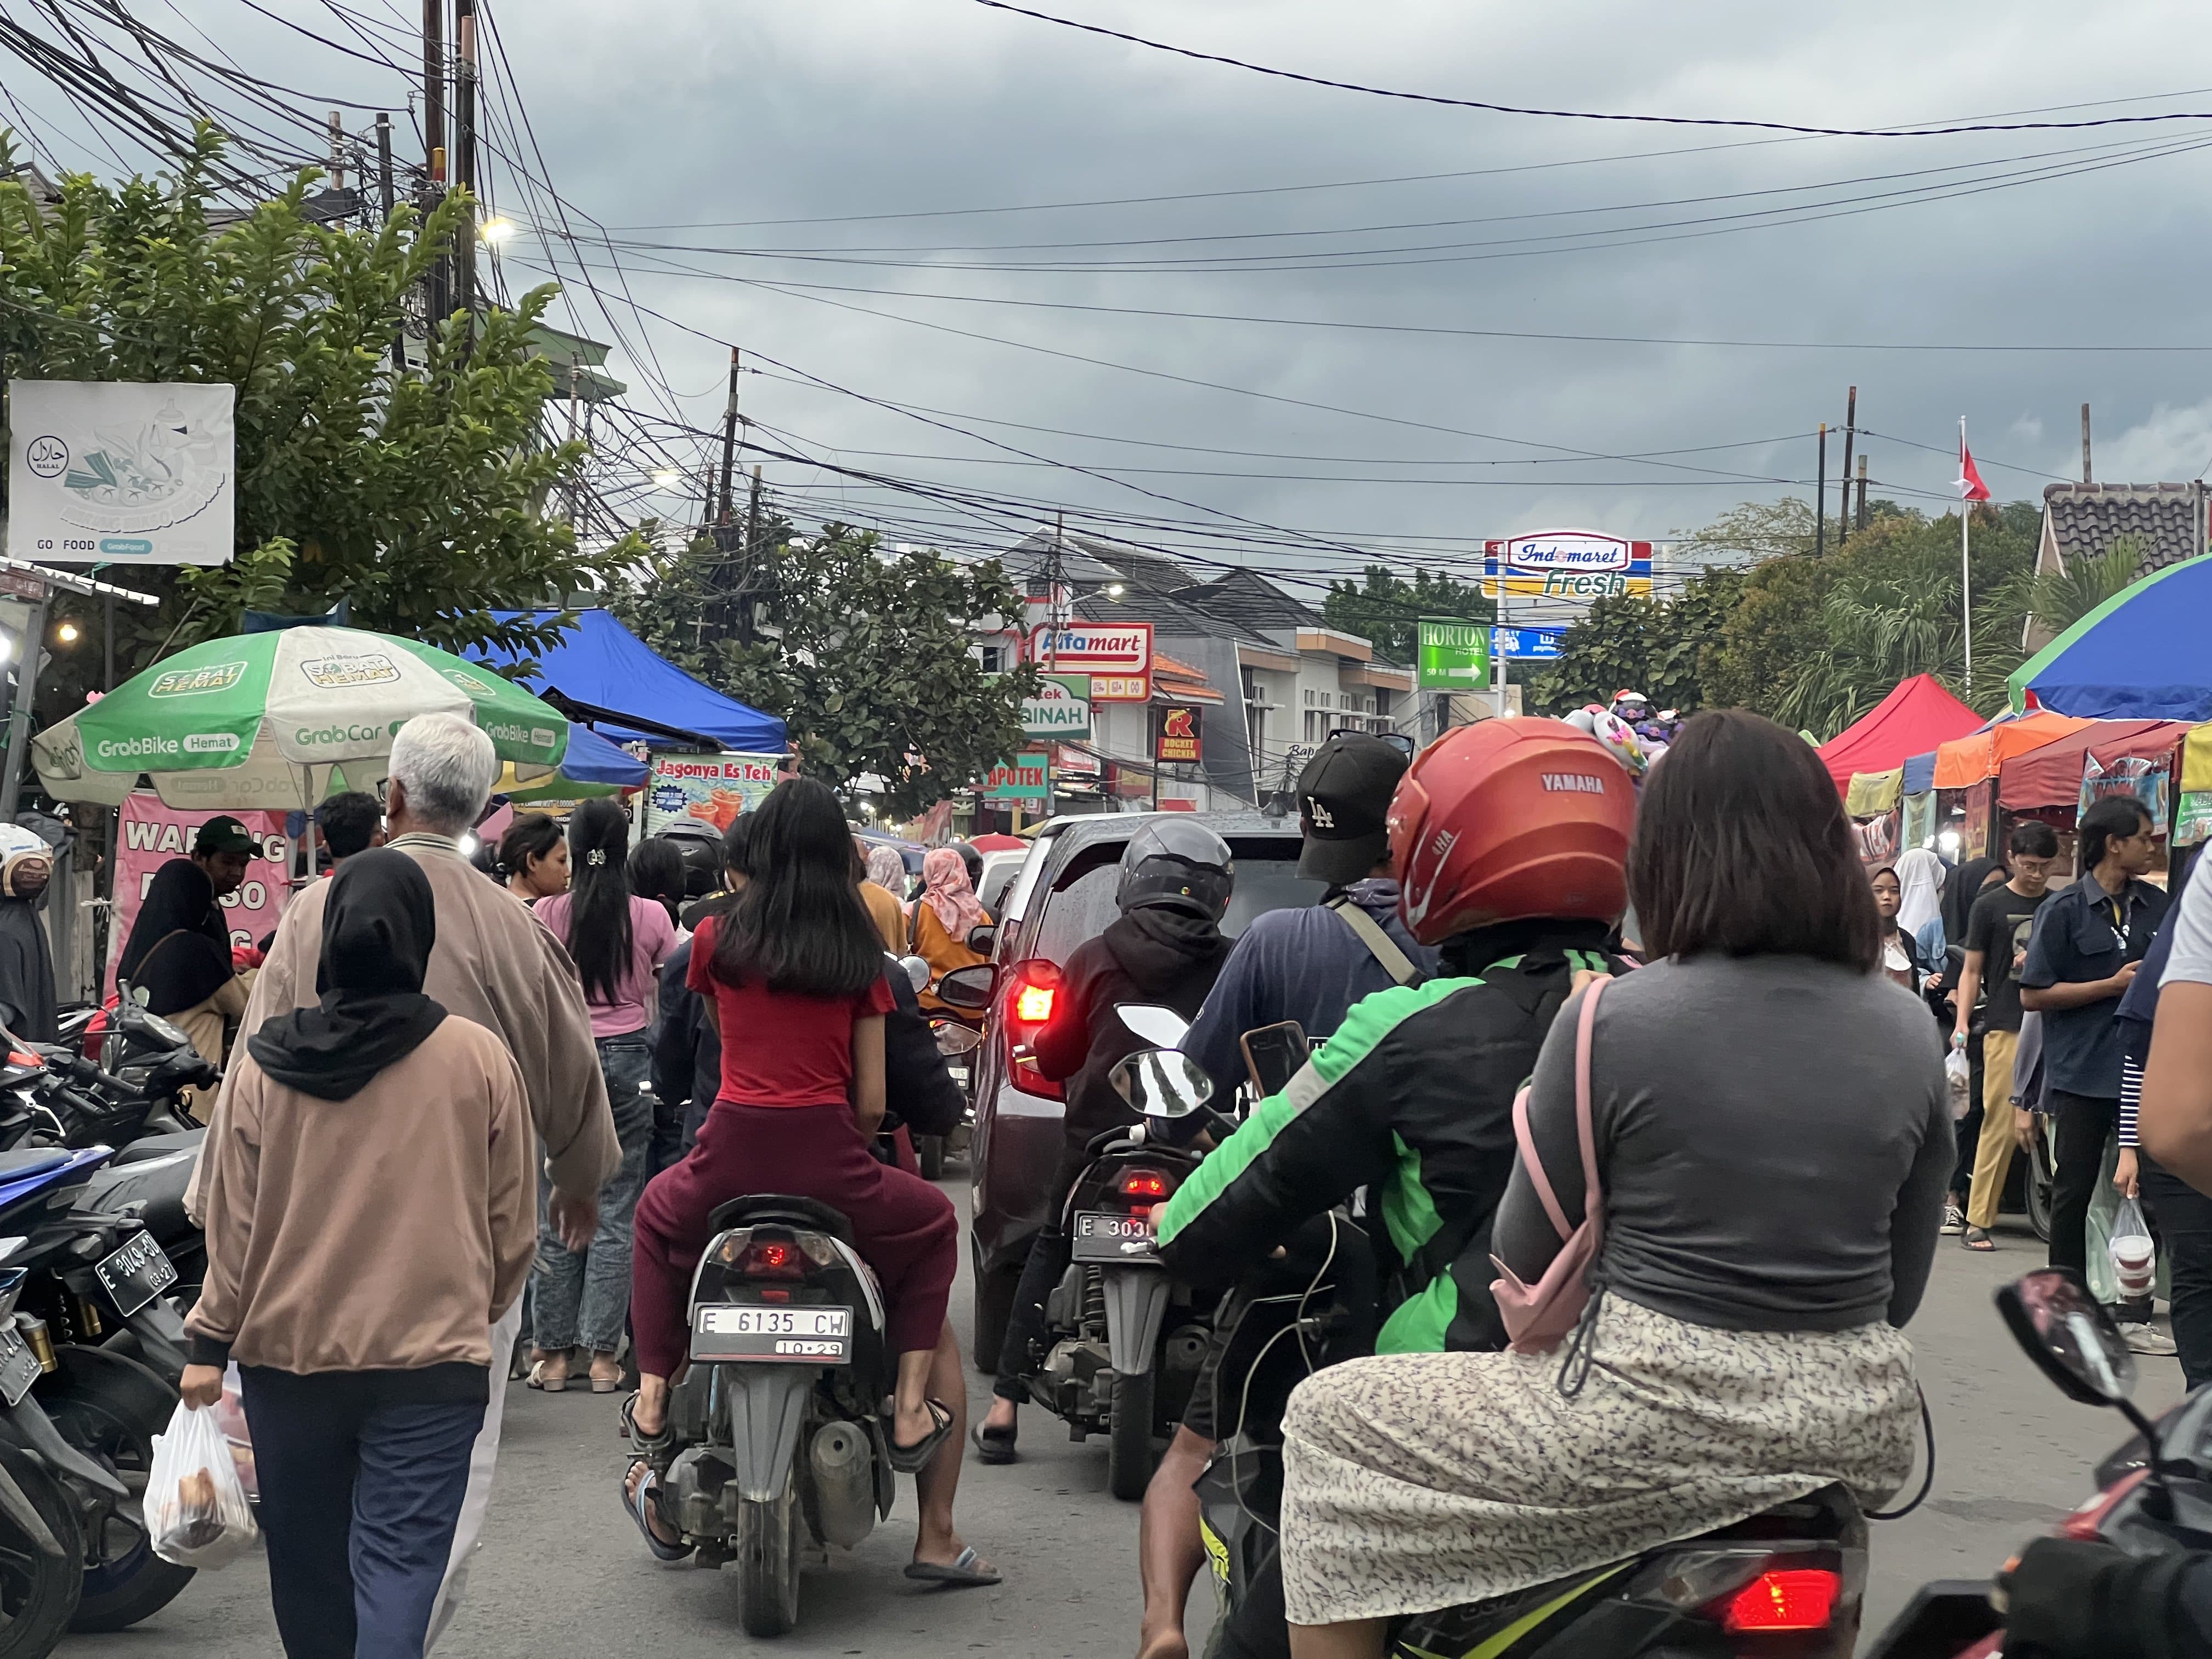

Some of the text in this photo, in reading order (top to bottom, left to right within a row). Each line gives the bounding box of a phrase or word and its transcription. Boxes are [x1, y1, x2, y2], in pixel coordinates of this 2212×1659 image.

[32, 441, 65, 462] حلال
[37, 540, 95, 551] GO FOOD
[1519, 544, 1618, 563] Indomaret
[1544, 569, 1627, 595] Fresh
[1042, 632, 1141, 651] Alfamart
[1423, 625, 1485, 646] HORTON
[1455, 647, 1483, 656] HOTEL
[313, 665, 395, 685] HEMAT
[1426, 668, 1436, 676] 50
[155, 673, 238, 693] HEMAT
[296, 724, 382, 746] GrabCar
[486, 721, 528, 743] GrabBike
[98, 736, 178, 757] GrabBike
[191, 736, 232, 749] Hemat
[1162, 748, 1196, 758] CHICKEN
[1164, 738, 1194, 748] ROCKET
[656, 759, 772, 781] Jagonya Es Teh
[988, 766, 1045, 786] APOTEK
[1542, 774, 1604, 794] YAMAHA
[1307, 796, 1334, 827] LA
[1082, 1219, 1092, 1236] E
[100, 1267, 116, 1290] E
[703, 1312, 844, 1334] E 6135 CW
